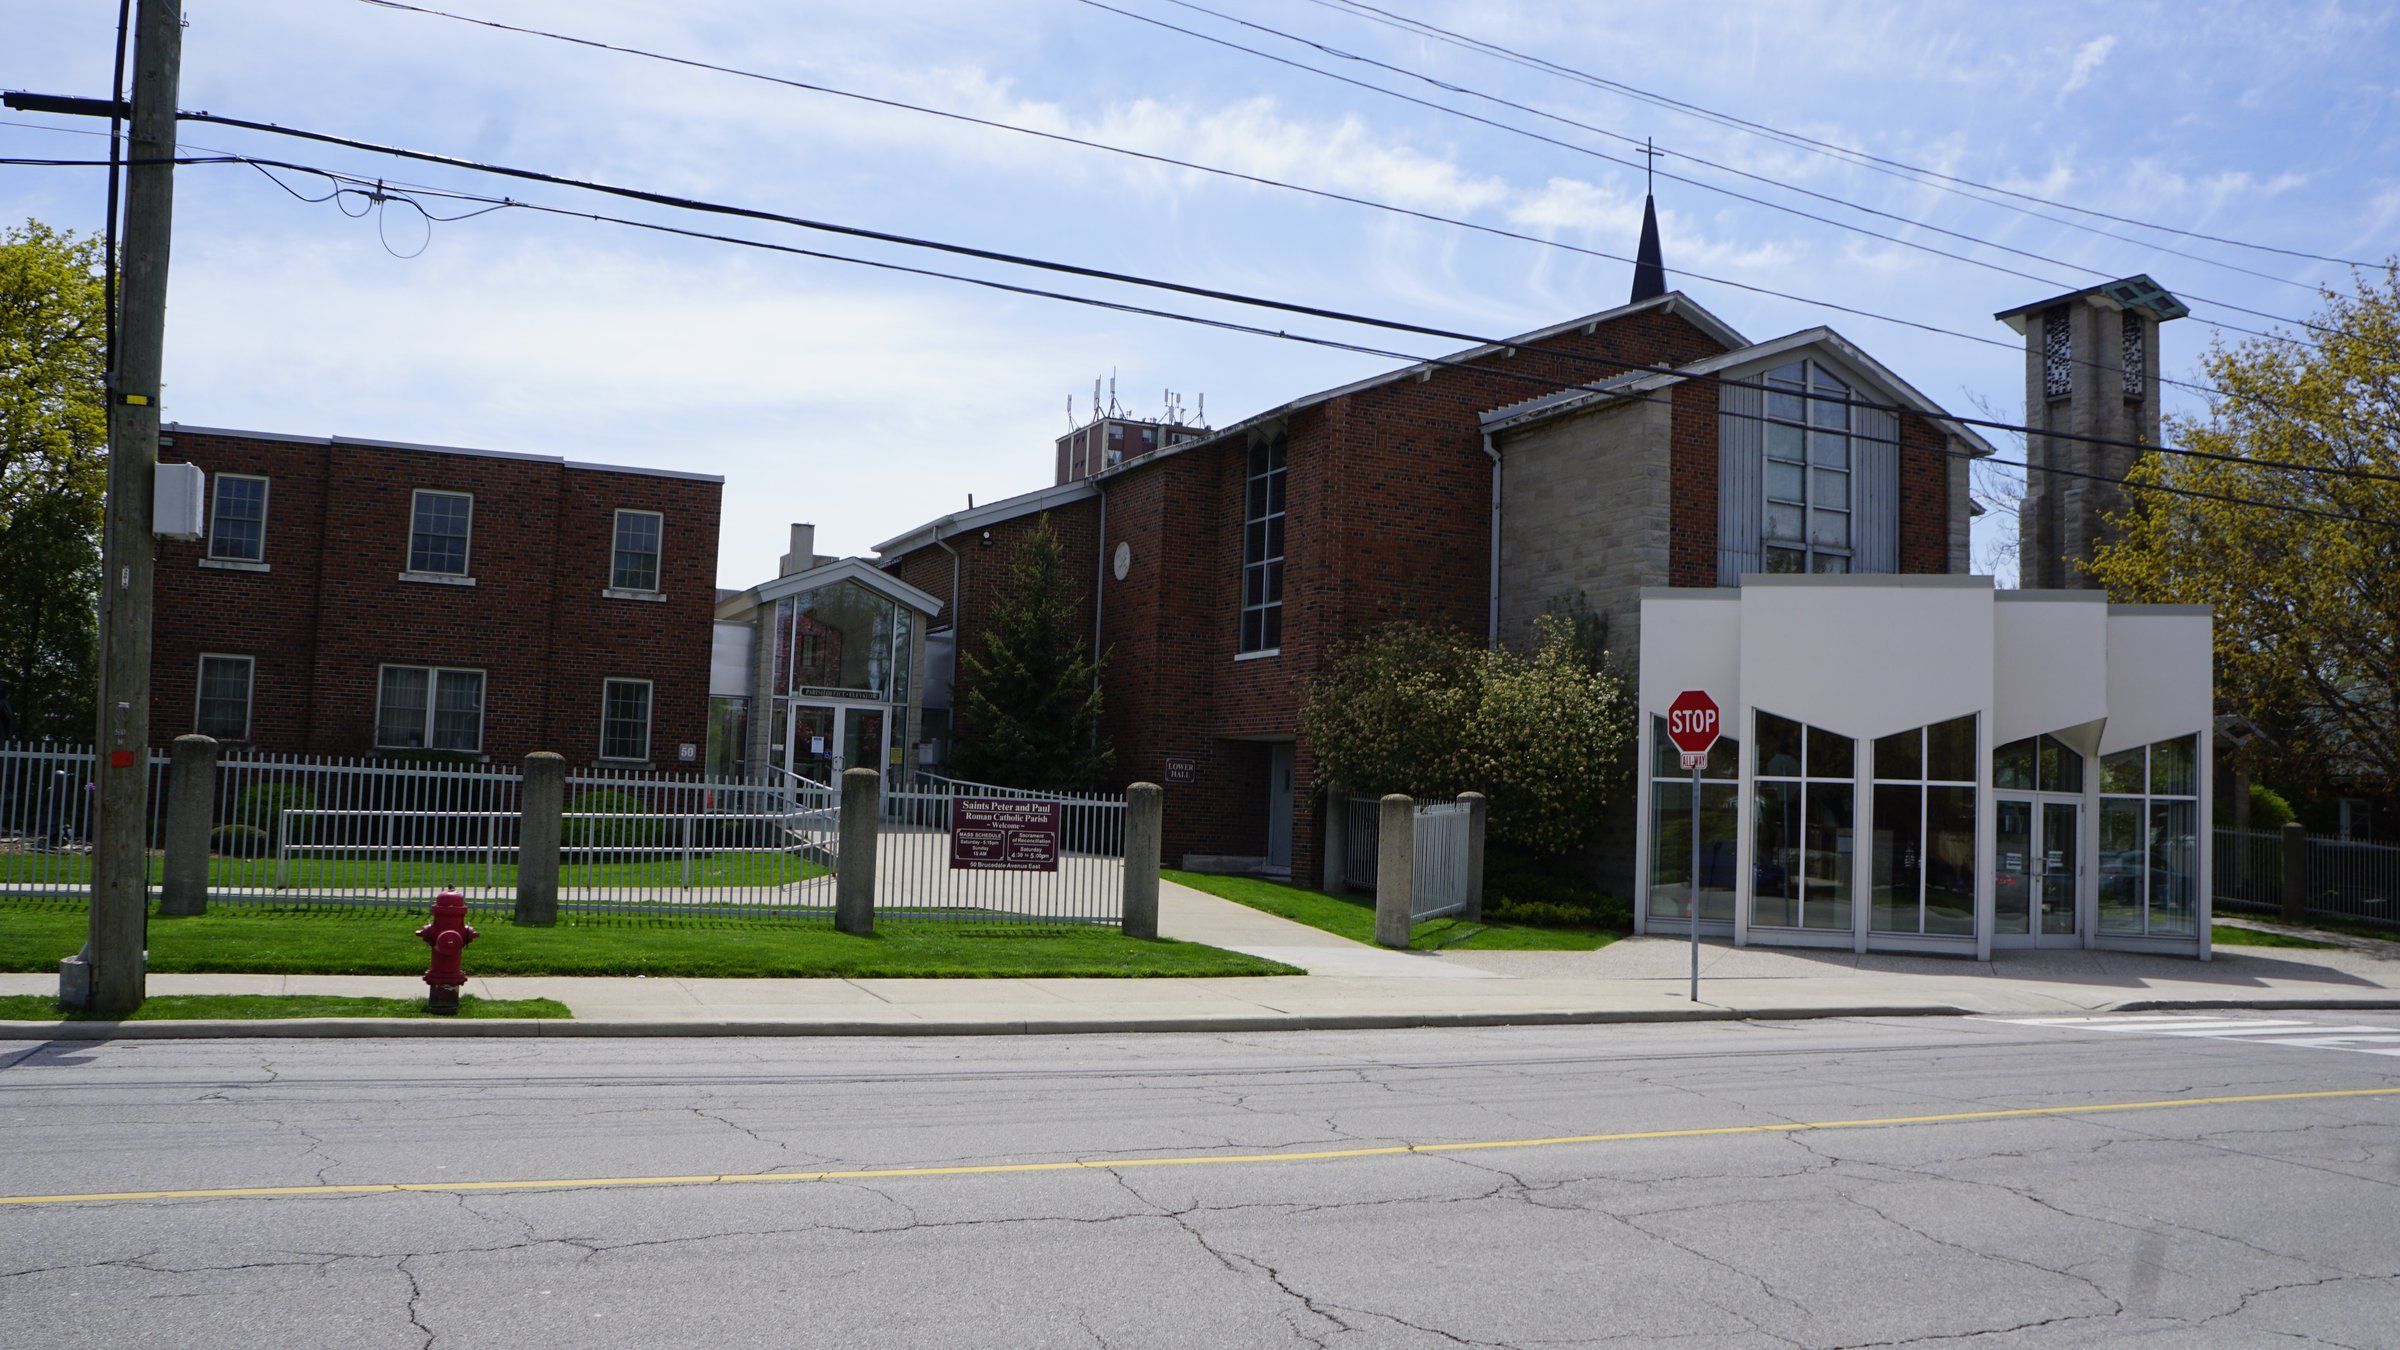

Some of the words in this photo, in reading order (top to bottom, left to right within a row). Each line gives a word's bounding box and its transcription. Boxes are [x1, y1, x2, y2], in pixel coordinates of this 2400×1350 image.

[1672, 709, 1716, 733] STOP
[681, 747, 694, 757] 50
[1168, 763, 1193, 771] LOWER
[962, 801, 989, 810] Saints
[991, 802, 1013, 812] Peter
[1015, 803, 1030, 812] and
[1032, 804, 1050, 813] Paul
[966, 812, 992, 820] Roman
[993, 813, 1023, 822] Catholic
[1025, 815, 1048, 823] Parish
